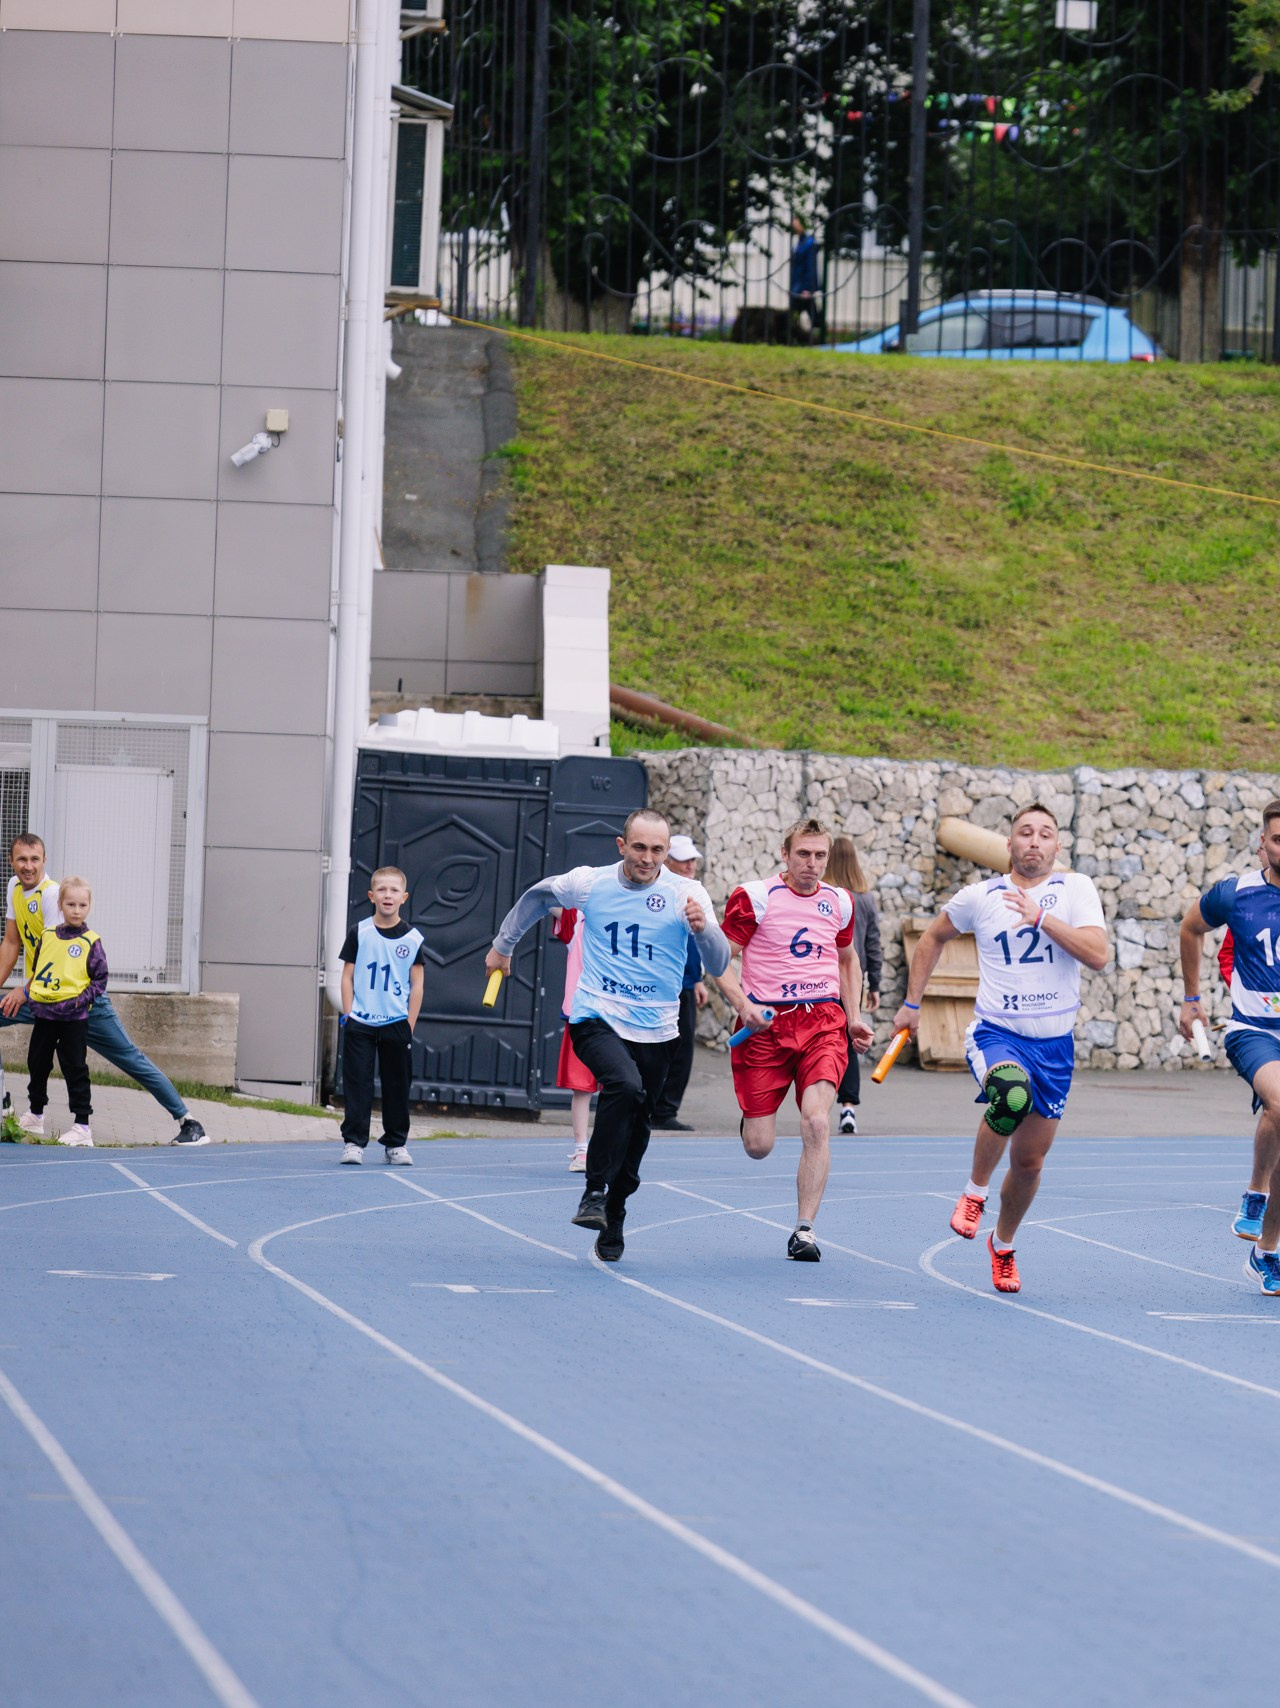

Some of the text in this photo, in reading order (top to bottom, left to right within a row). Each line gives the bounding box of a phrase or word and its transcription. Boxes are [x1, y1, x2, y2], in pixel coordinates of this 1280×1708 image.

[604, 922, 640, 957] 11
[790, 927, 813, 958] 6
[994, 927, 1044, 965] 12
[36, 962, 54, 988] 4
[367, 962, 391, 992] 11
[619, 983, 657, 993] КОМОС
[801, 982, 829, 991] КОМОС
[1022, 992, 1058, 1002] КОМОС
